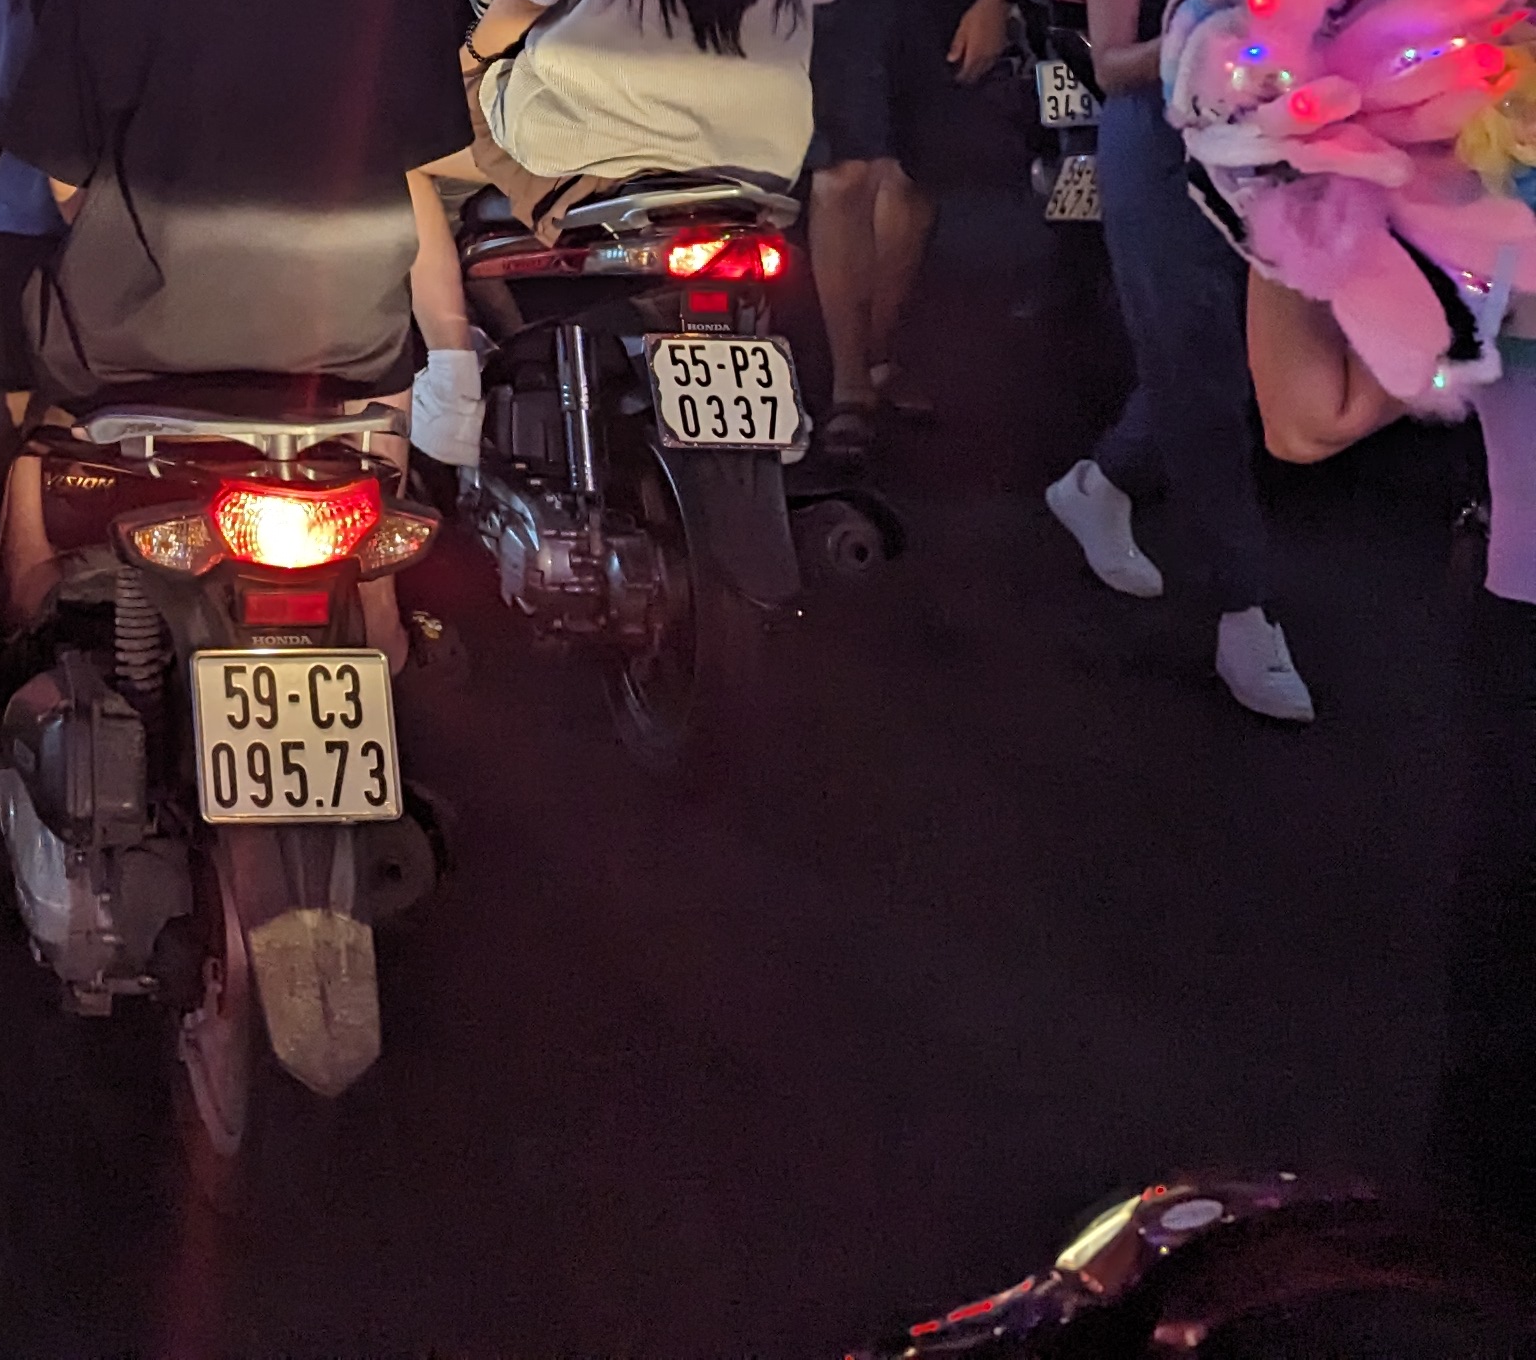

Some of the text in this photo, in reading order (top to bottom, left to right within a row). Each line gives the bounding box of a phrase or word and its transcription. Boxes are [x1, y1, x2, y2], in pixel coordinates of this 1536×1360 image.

[686, 322, 731, 332] HONDA
[667, 343, 774, 389] 55-P3
[678, 393, 779, 441] 0337
[252, 635, 313, 646] HONDA
[223, 663, 364, 731] 59-C3
[210, 740, 388, 810] 095.73
